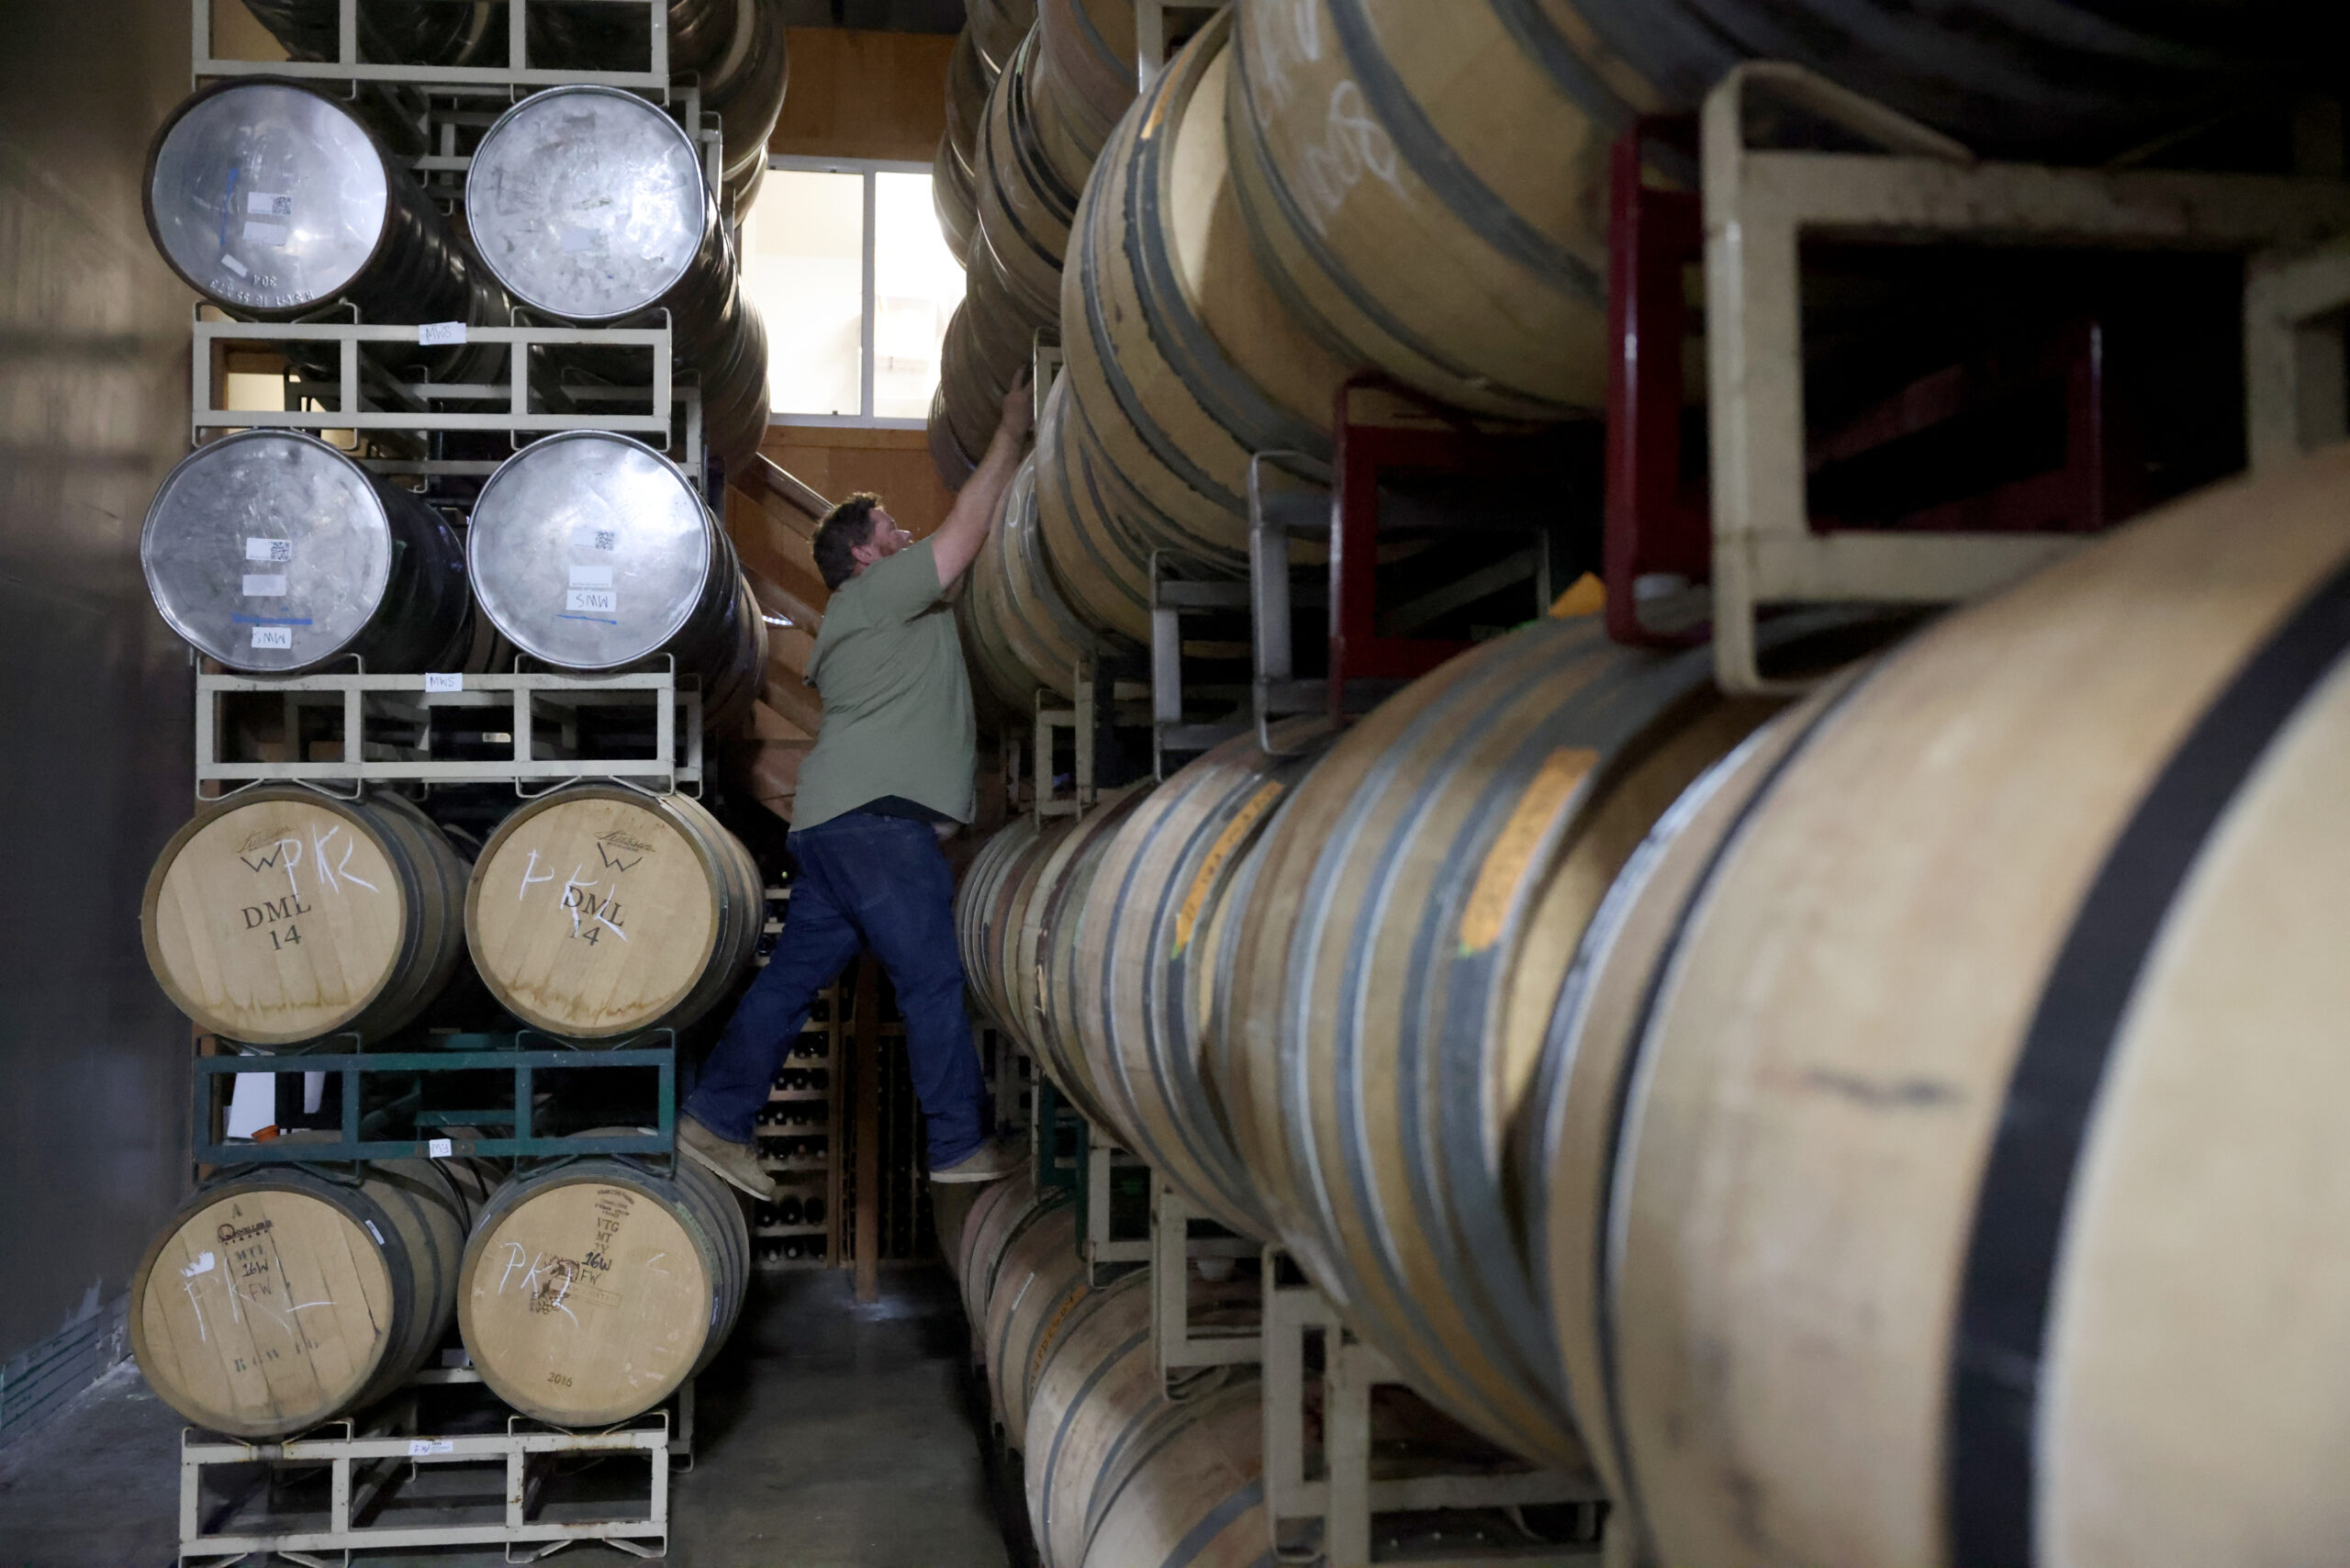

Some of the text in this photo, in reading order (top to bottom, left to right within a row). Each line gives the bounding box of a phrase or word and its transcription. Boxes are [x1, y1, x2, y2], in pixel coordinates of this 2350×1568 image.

[430, 676, 455, 688] MWS
[241, 893, 311, 929] DML
[564, 885, 624, 926] DML
[270, 924, 302, 951] 14
[569, 919, 601, 946] 14
[242, 1259, 269, 1277] 16W
[581, 1251, 612, 1271] 16W
[580, 1269, 603, 1285] FW
[249, 1277, 272, 1303] FW
[547, 1372, 574, 1387] 2016
